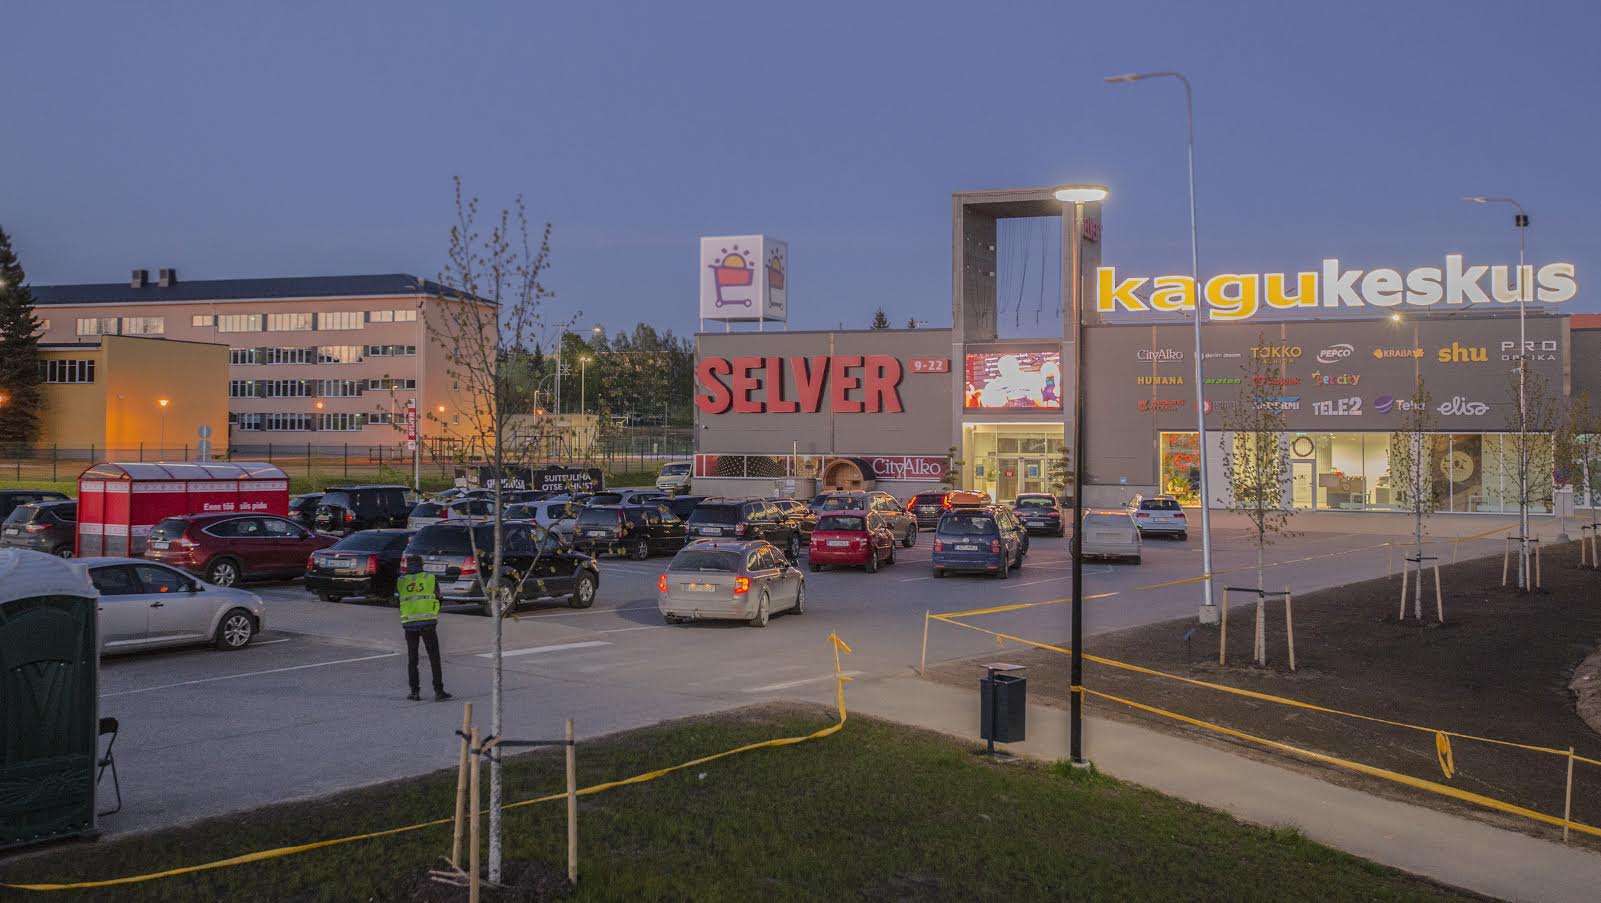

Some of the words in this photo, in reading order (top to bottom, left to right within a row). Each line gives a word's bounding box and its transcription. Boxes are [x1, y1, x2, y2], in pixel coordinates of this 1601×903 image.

[1096, 254, 1578, 321] kagukeskus
[1320, 349, 1351, 358] PEPCO
[1438, 342, 1489, 362] shu
[1501, 341, 1557, 351] PRO
[1137, 348, 1184, 361] CityAlko
[914, 359, 943, 371] 9-22
[695, 354, 905, 414] SELVER
[1137, 376, 1184, 385] HUMANA
[1312, 397, 1363, 416] TELE2
[1437, 396, 1490, 416] elisa
[873, 457, 942, 479] CityAlko
[541, 483, 563, 491] OTSE
